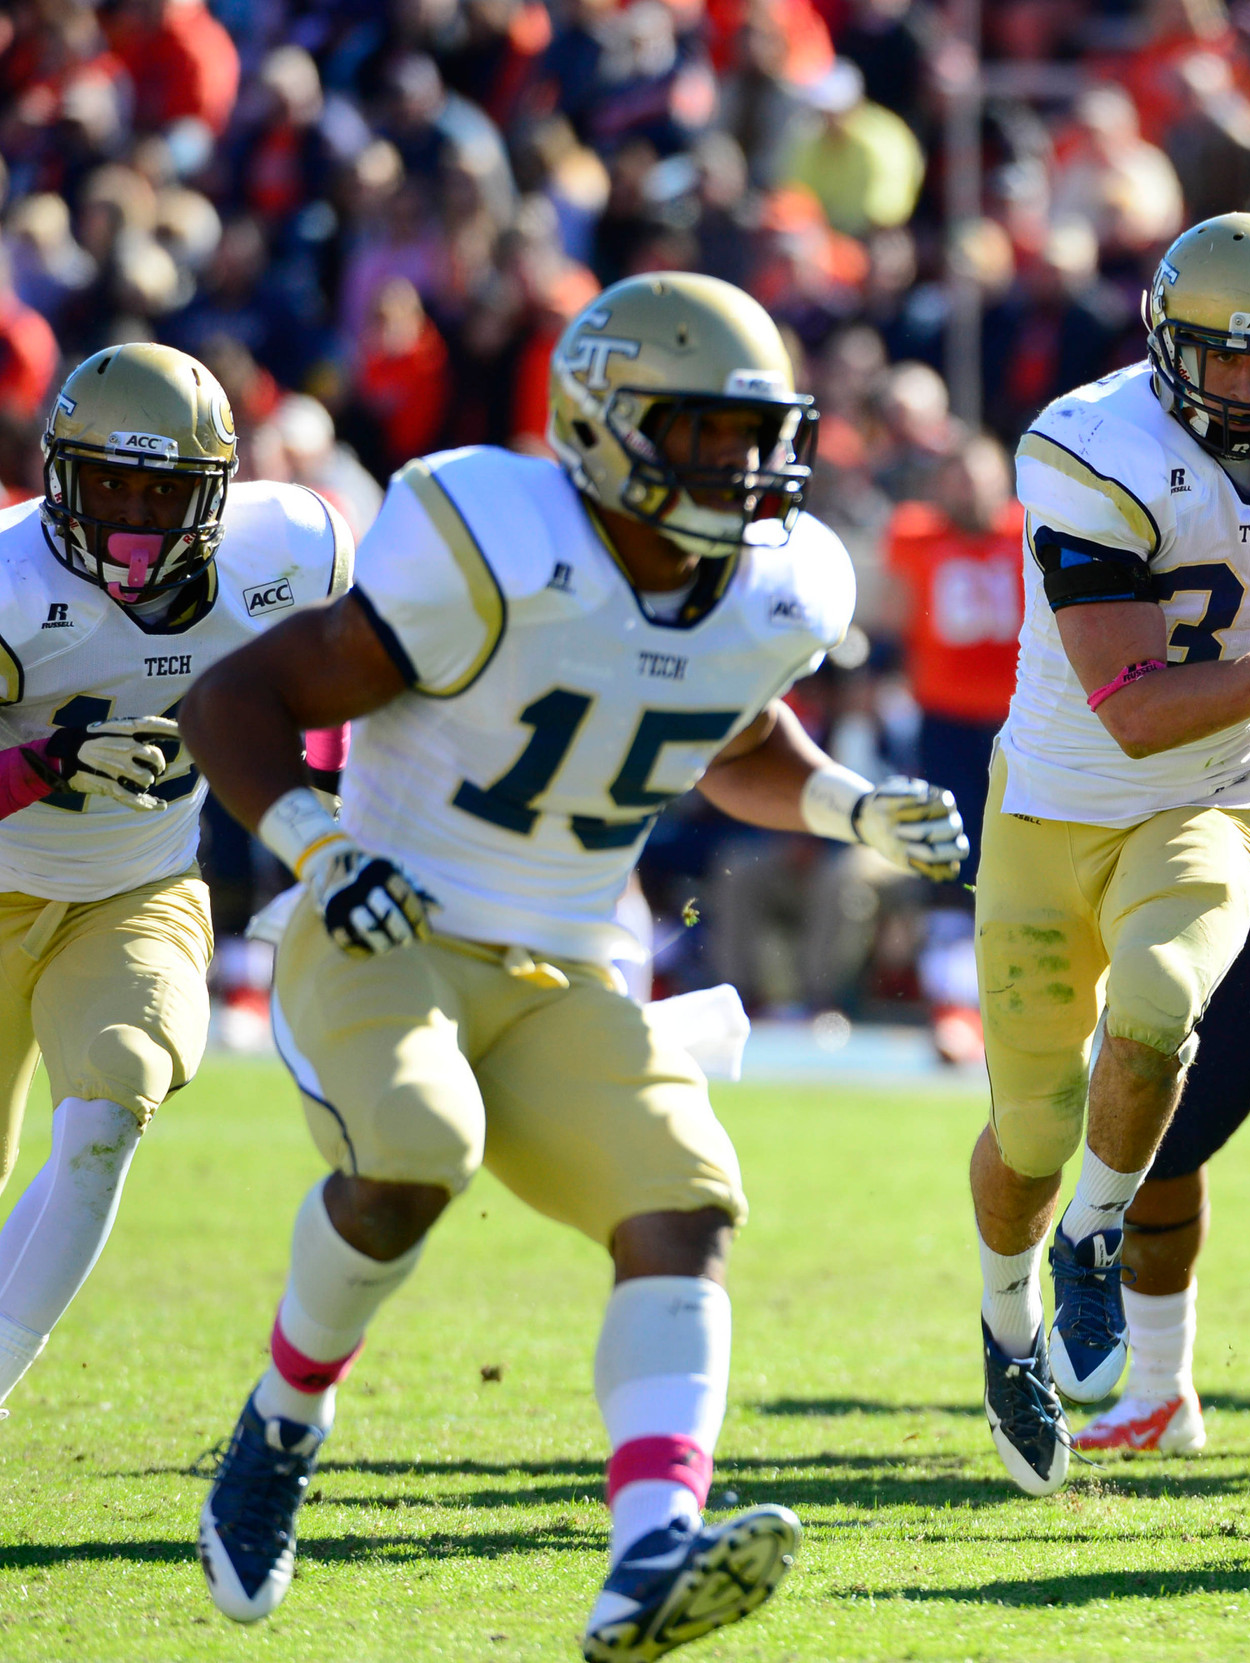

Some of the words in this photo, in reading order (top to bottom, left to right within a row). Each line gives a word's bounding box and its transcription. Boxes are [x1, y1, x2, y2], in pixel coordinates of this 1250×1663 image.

[126, 435, 161, 450] ACC
[1170, 468, 1186, 487] R
[250, 584, 291, 610] ACC
[47, 602, 69, 621] R
[41, 621, 75, 630] RUSSELL
[144, 655, 192, 677] TECH
[640, 652, 689, 681] TECH
[450, 687, 743, 853] 15
